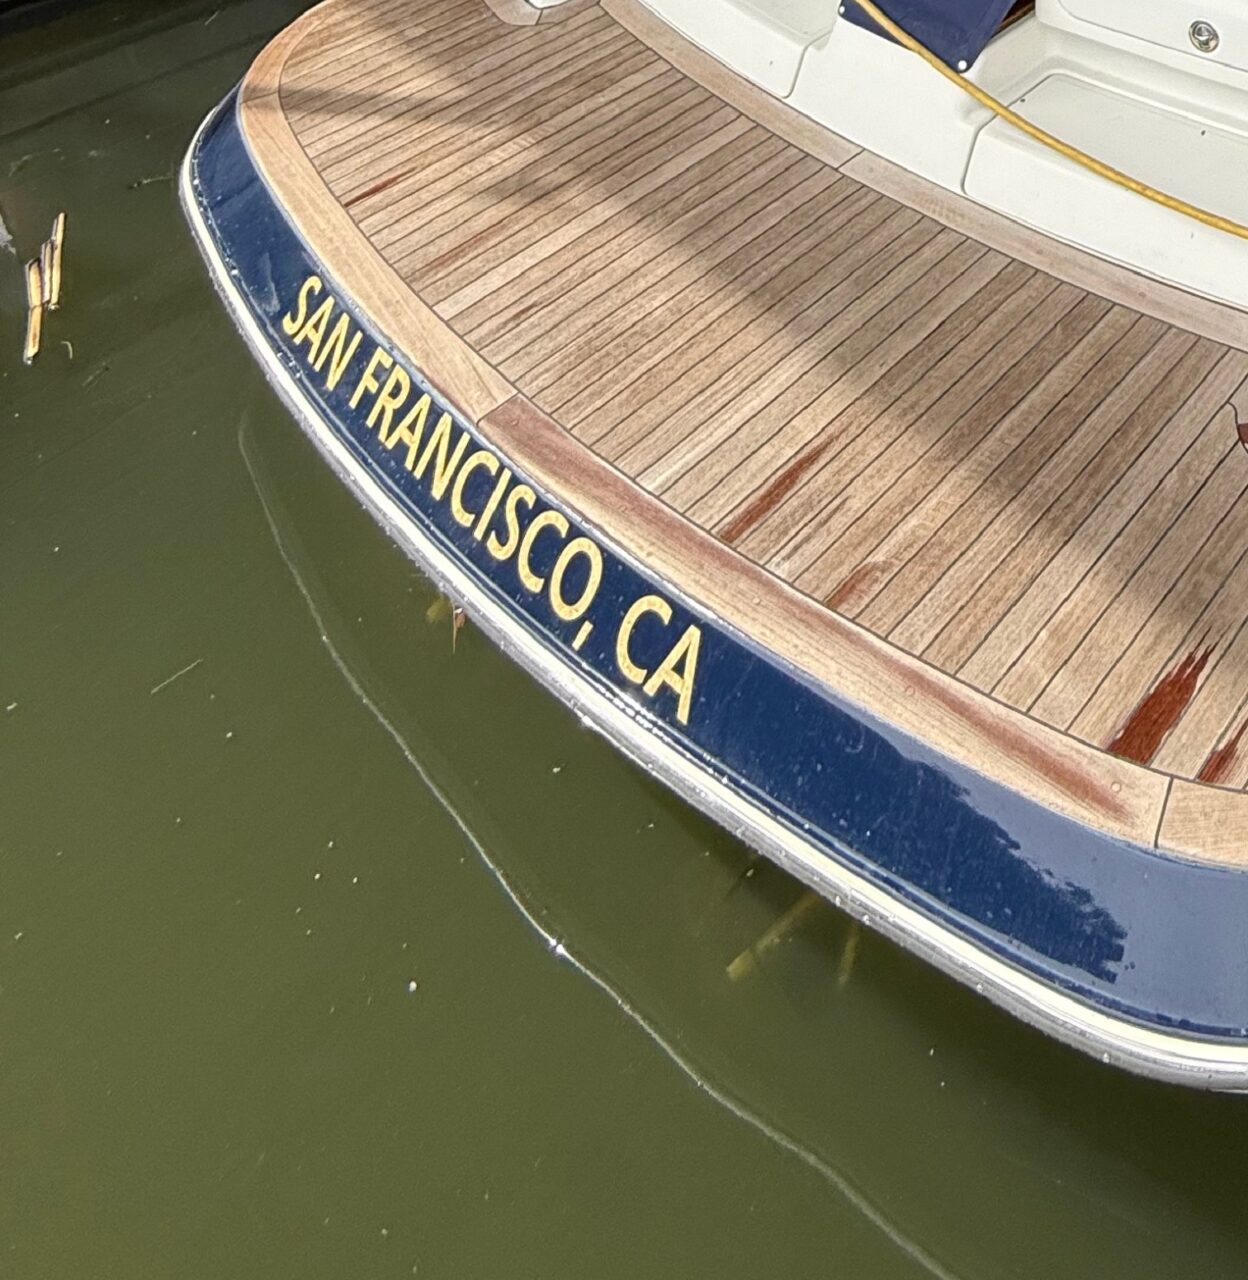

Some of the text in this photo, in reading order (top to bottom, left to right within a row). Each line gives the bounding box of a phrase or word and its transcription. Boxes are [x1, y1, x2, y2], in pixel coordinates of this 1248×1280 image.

[282, 275, 702, 726] SAN FRANCISCO, CA
